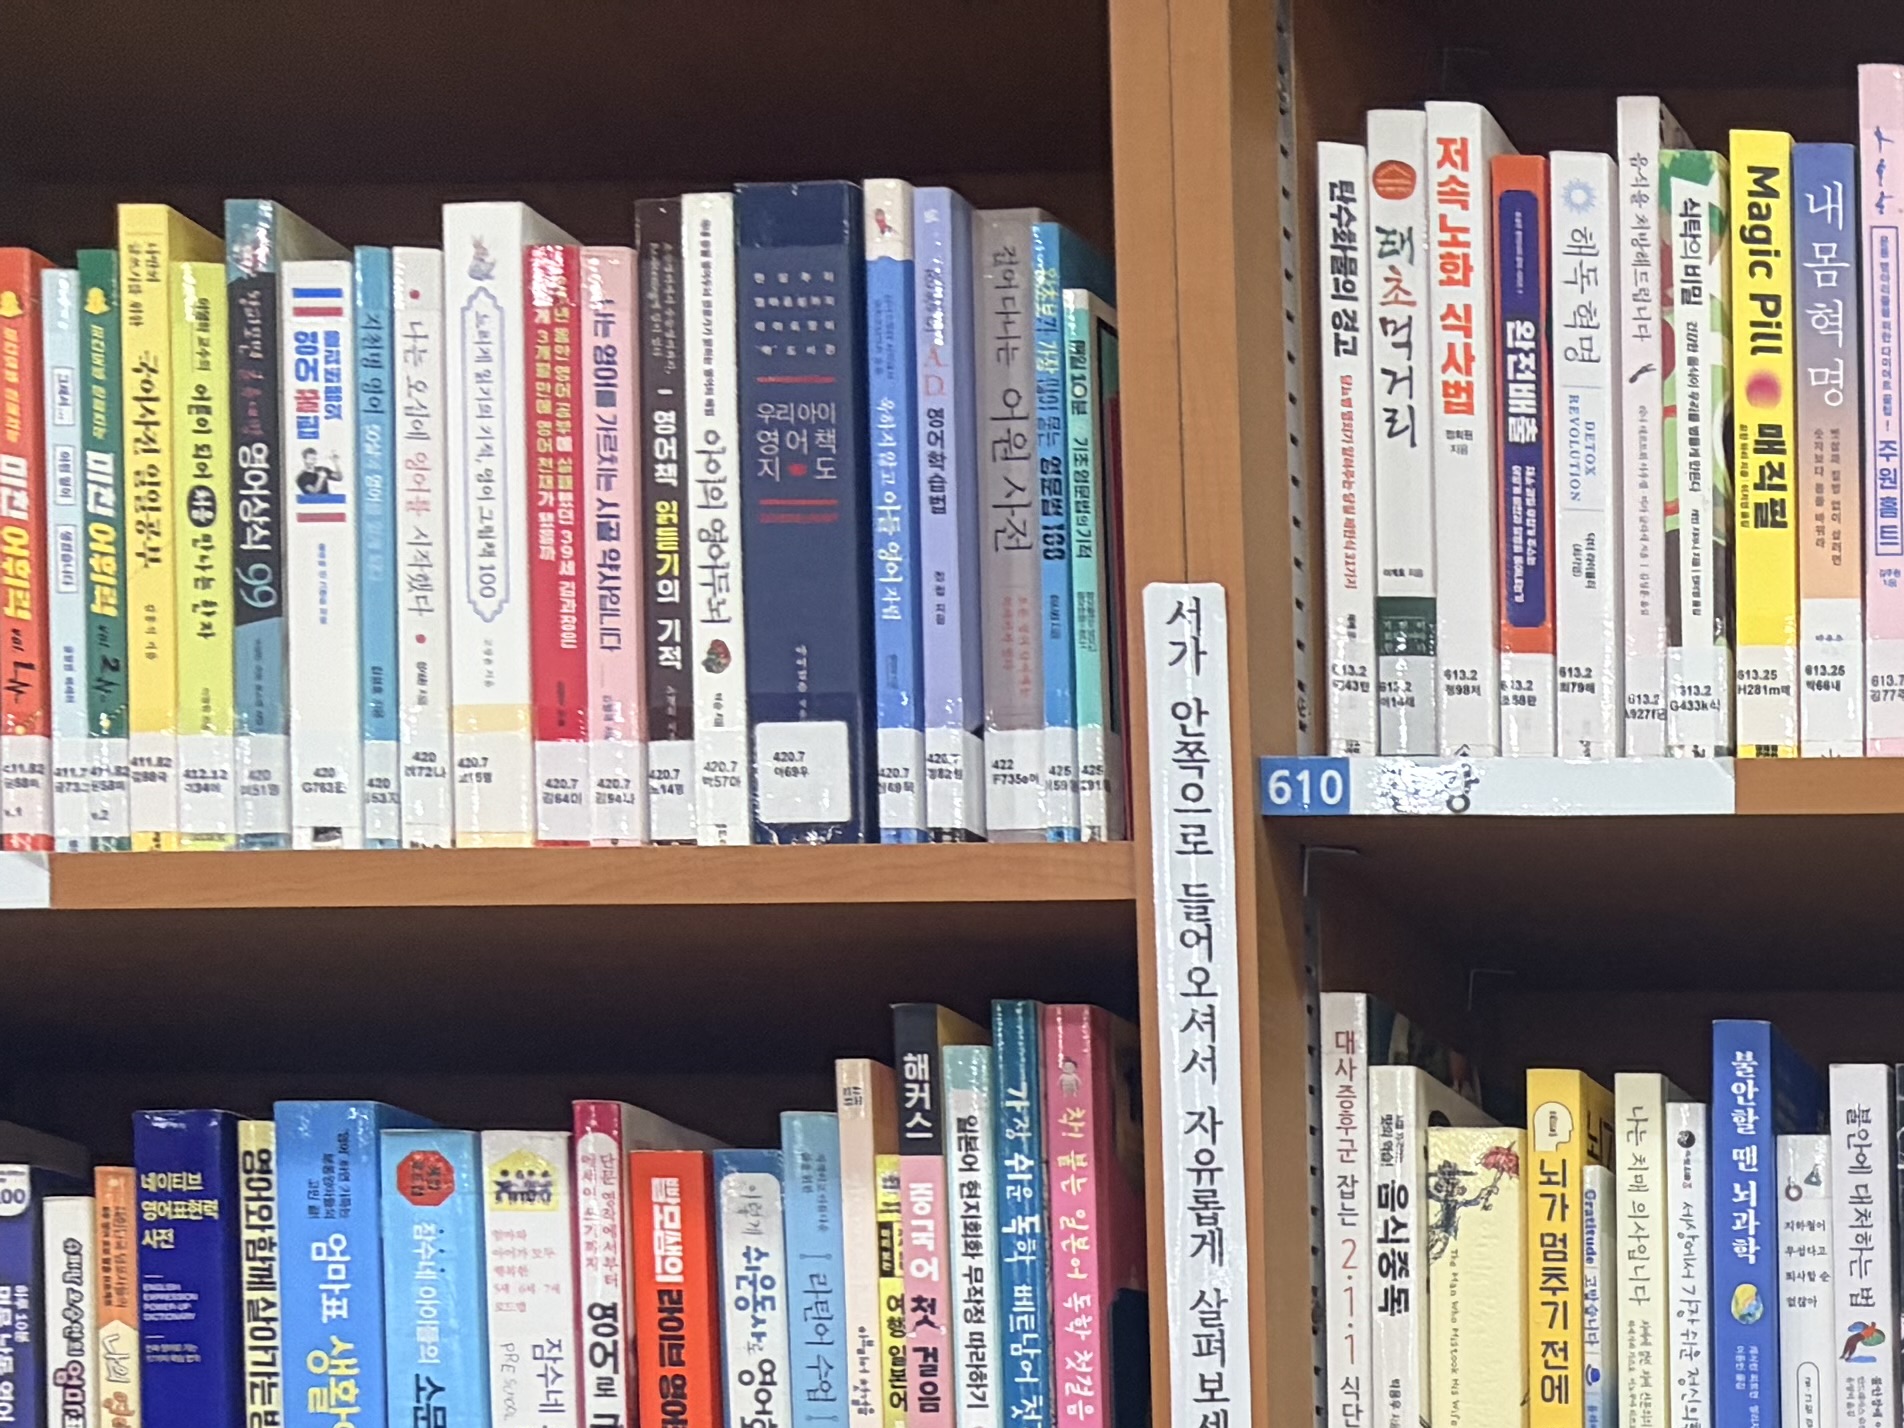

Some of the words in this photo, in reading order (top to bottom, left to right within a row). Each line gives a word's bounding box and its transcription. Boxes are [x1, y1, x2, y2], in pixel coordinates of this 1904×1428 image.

[1437, 137, 1473, 287] 저속노화
[1740, 166, 1780, 279] Magic
[1440, 304, 1475, 415] 식사법
[1749, 293, 1782, 355] Pill
[239, 443, 271, 549] 영어상식
[1569, 395, 1580, 500] REVOLUTION
[1585, 422, 1595, 475] DETOX
[1753, 424, 1787, 528] 매직필
[237, 563, 276, 607] 99
[1167, 596, 1208, 676] 서가
[774, 751, 805, 762] 420.7
[1171, 697, 1214, 856] 안쪽으로
[1269, 770, 1342, 804] 610
[1176, 884, 1218, 1085] 들어오셔서
[1184, 1105, 1226, 1268] 자유롭게
[1539, 1159, 1569, 1222] 뇌가
[1539, 1233, 1569, 1330] 멈추기
[1541, 1341, 1568, 1404] 전에
